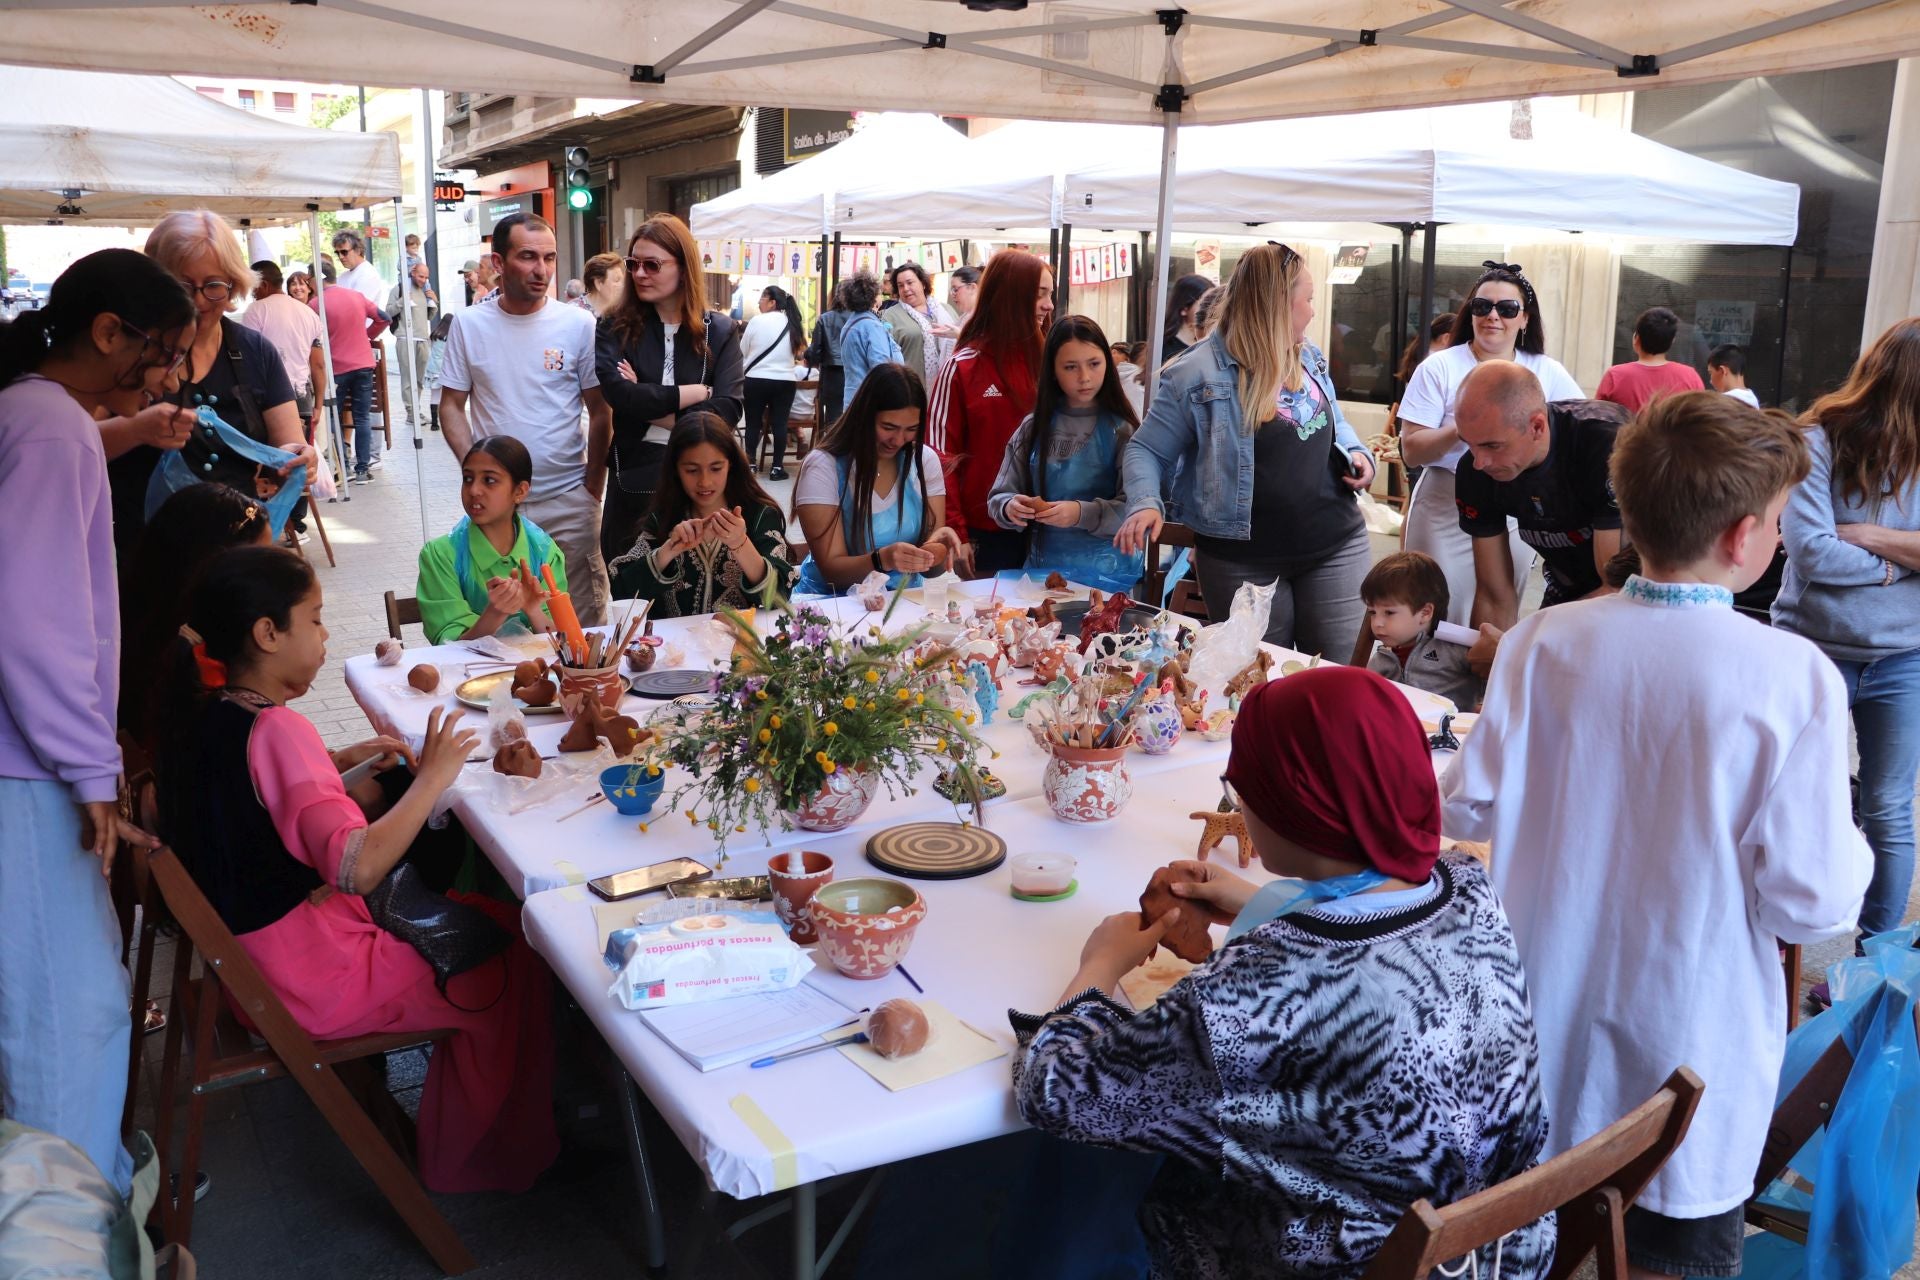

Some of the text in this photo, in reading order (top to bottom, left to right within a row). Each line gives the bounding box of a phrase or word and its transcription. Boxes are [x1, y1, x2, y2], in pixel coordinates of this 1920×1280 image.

[794, 134, 813, 149] Salón
[814, 132, 824, 146] de
[645, 935, 773, 954] Frescas & perfumadas
